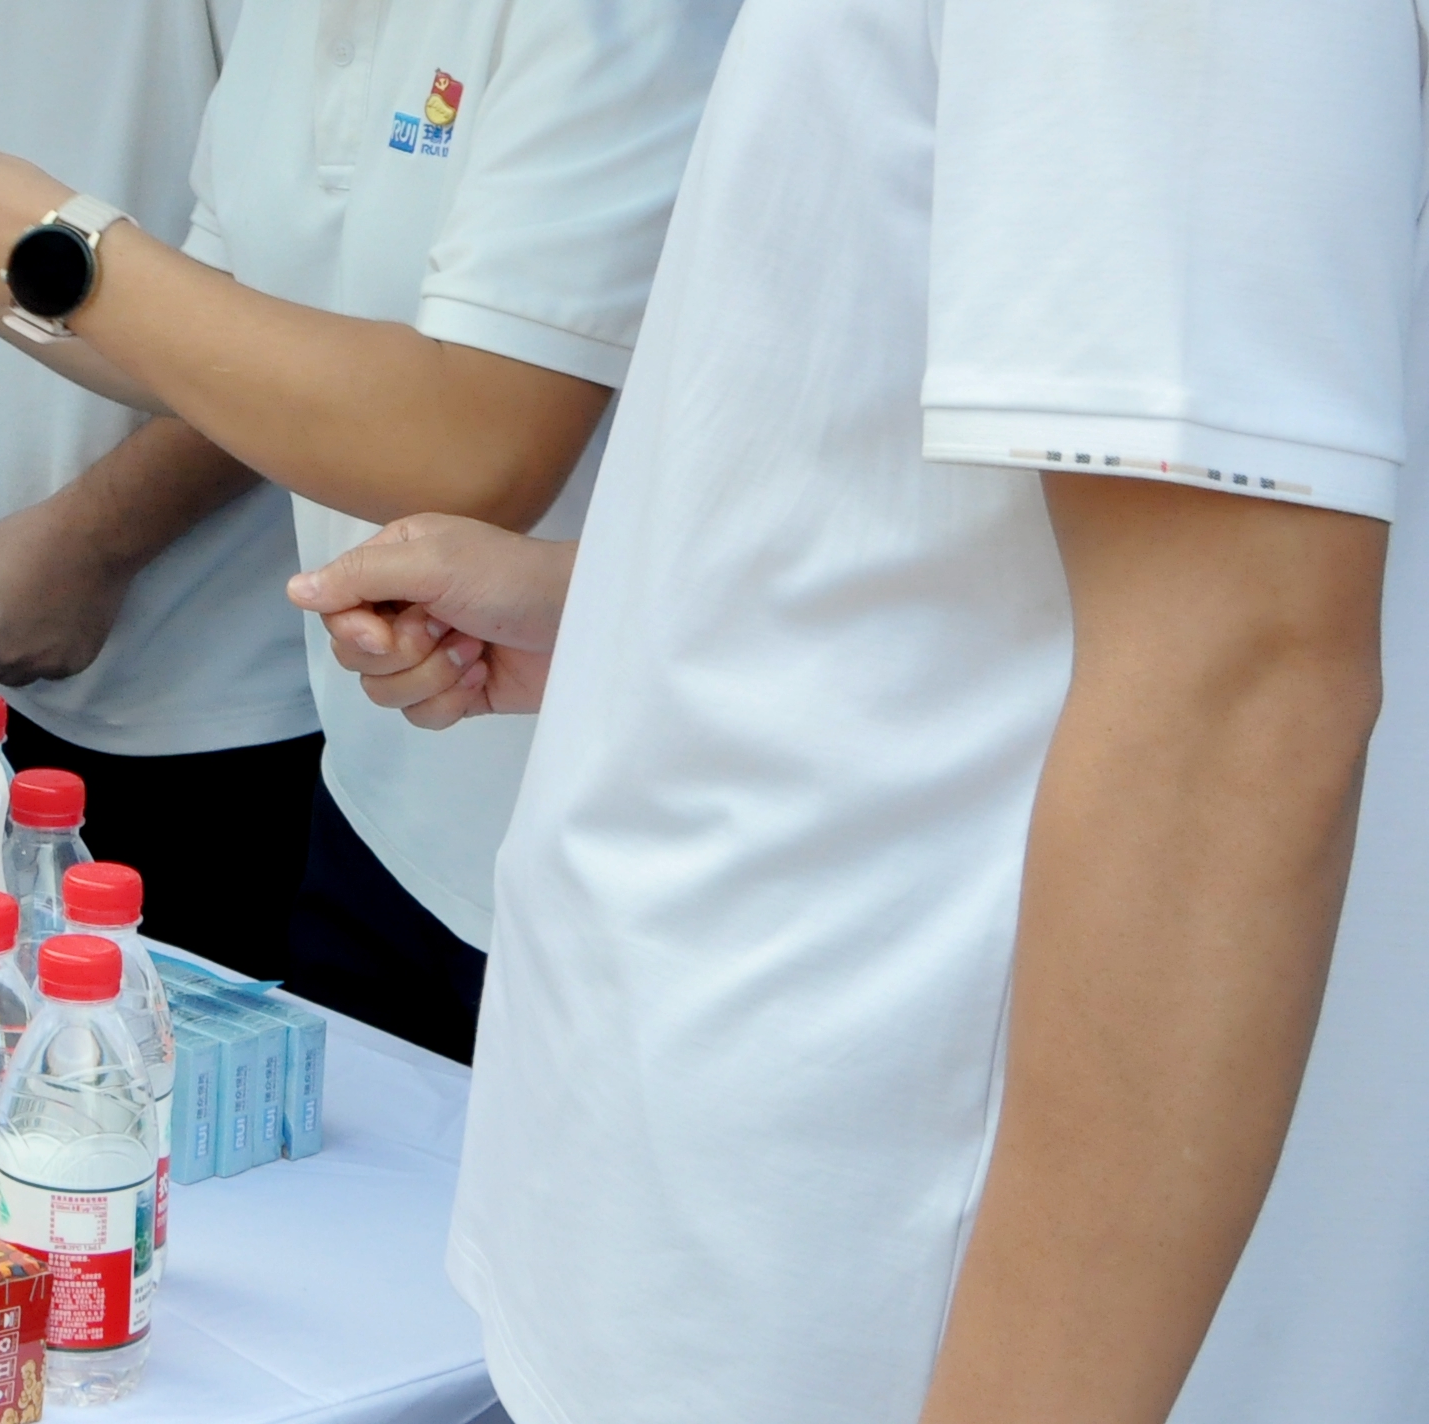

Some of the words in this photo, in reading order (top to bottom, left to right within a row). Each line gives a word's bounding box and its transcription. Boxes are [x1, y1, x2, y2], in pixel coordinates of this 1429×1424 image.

[391, 120, 418, 147] RUI
[266, 1109, 277, 1140] RUI
[305, 1101, 315, 1132] RUI
[198, 1126, 209, 1157] RUI
[235, 1118, 247, 1150] RUI
